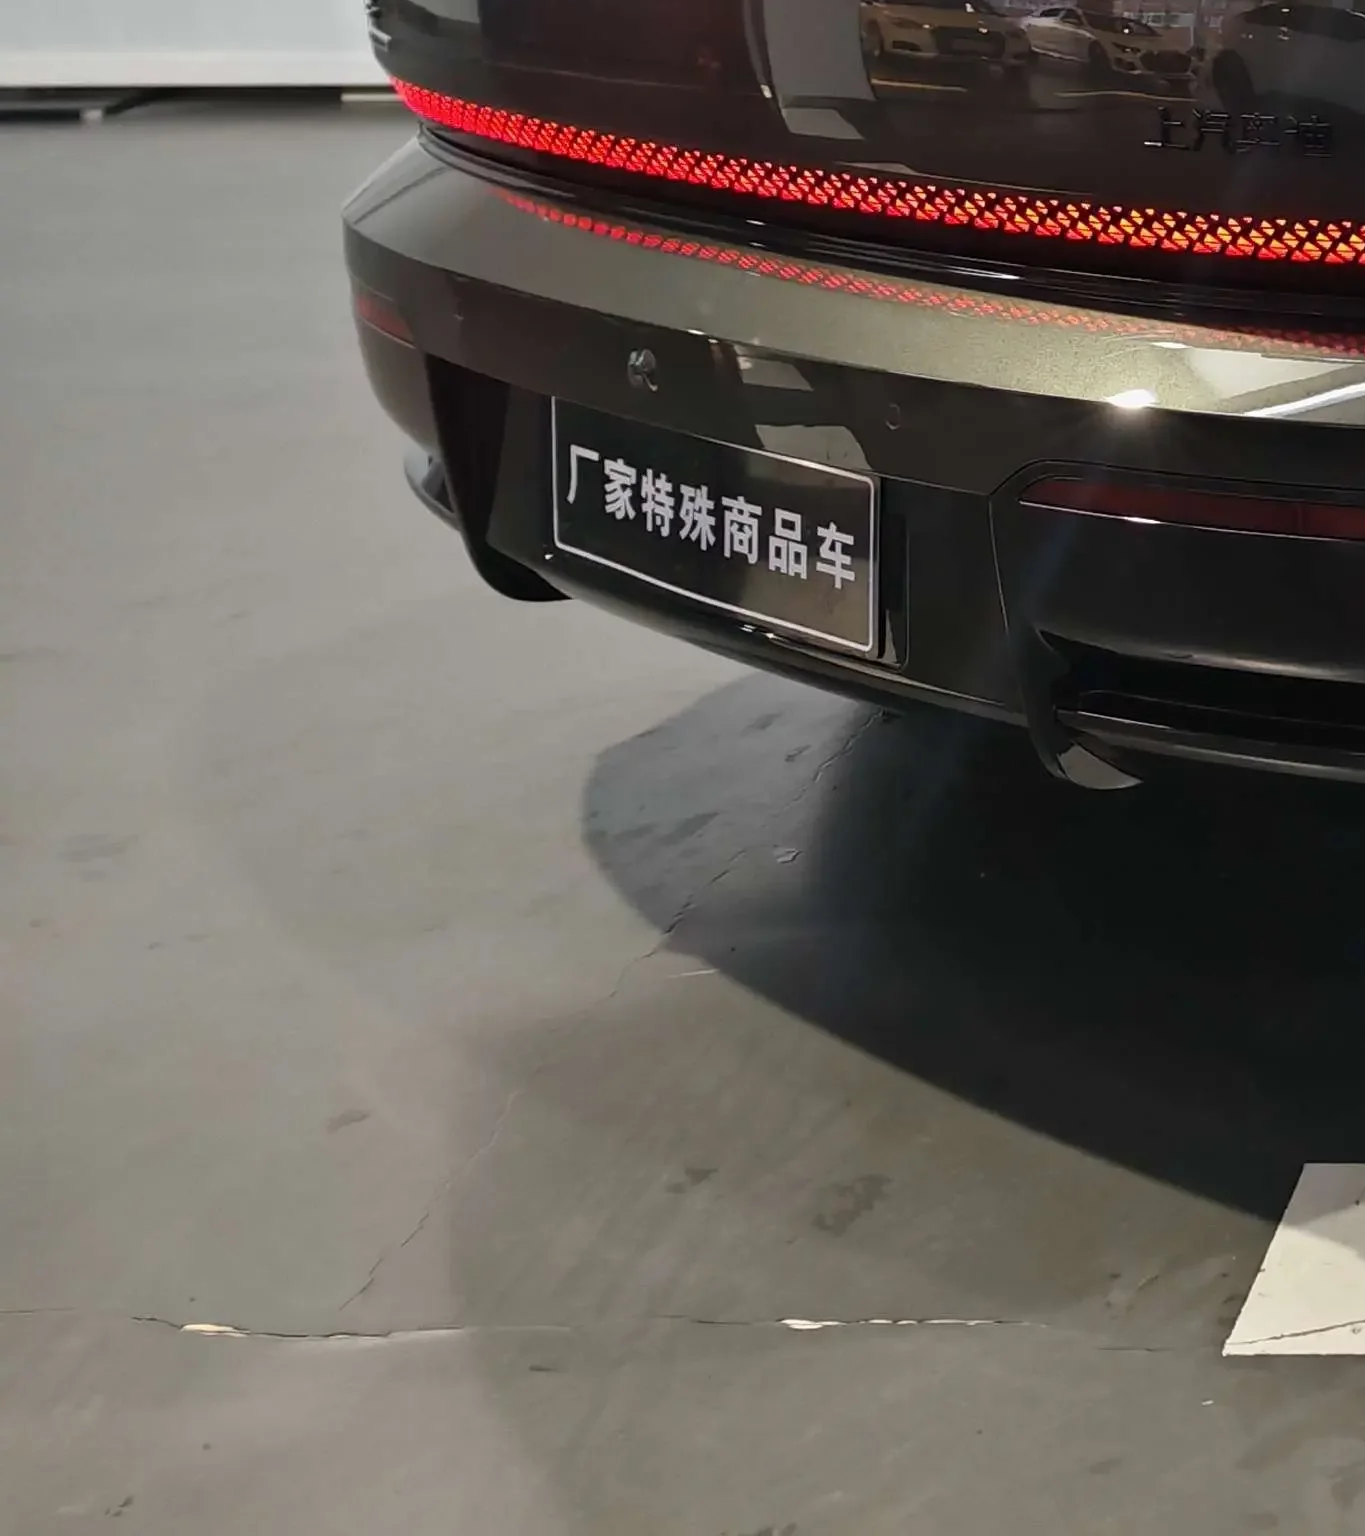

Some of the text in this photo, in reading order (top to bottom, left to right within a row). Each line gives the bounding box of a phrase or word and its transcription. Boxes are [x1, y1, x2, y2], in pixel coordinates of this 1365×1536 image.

[566, 443, 856, 590] 厂家特殊商品车
